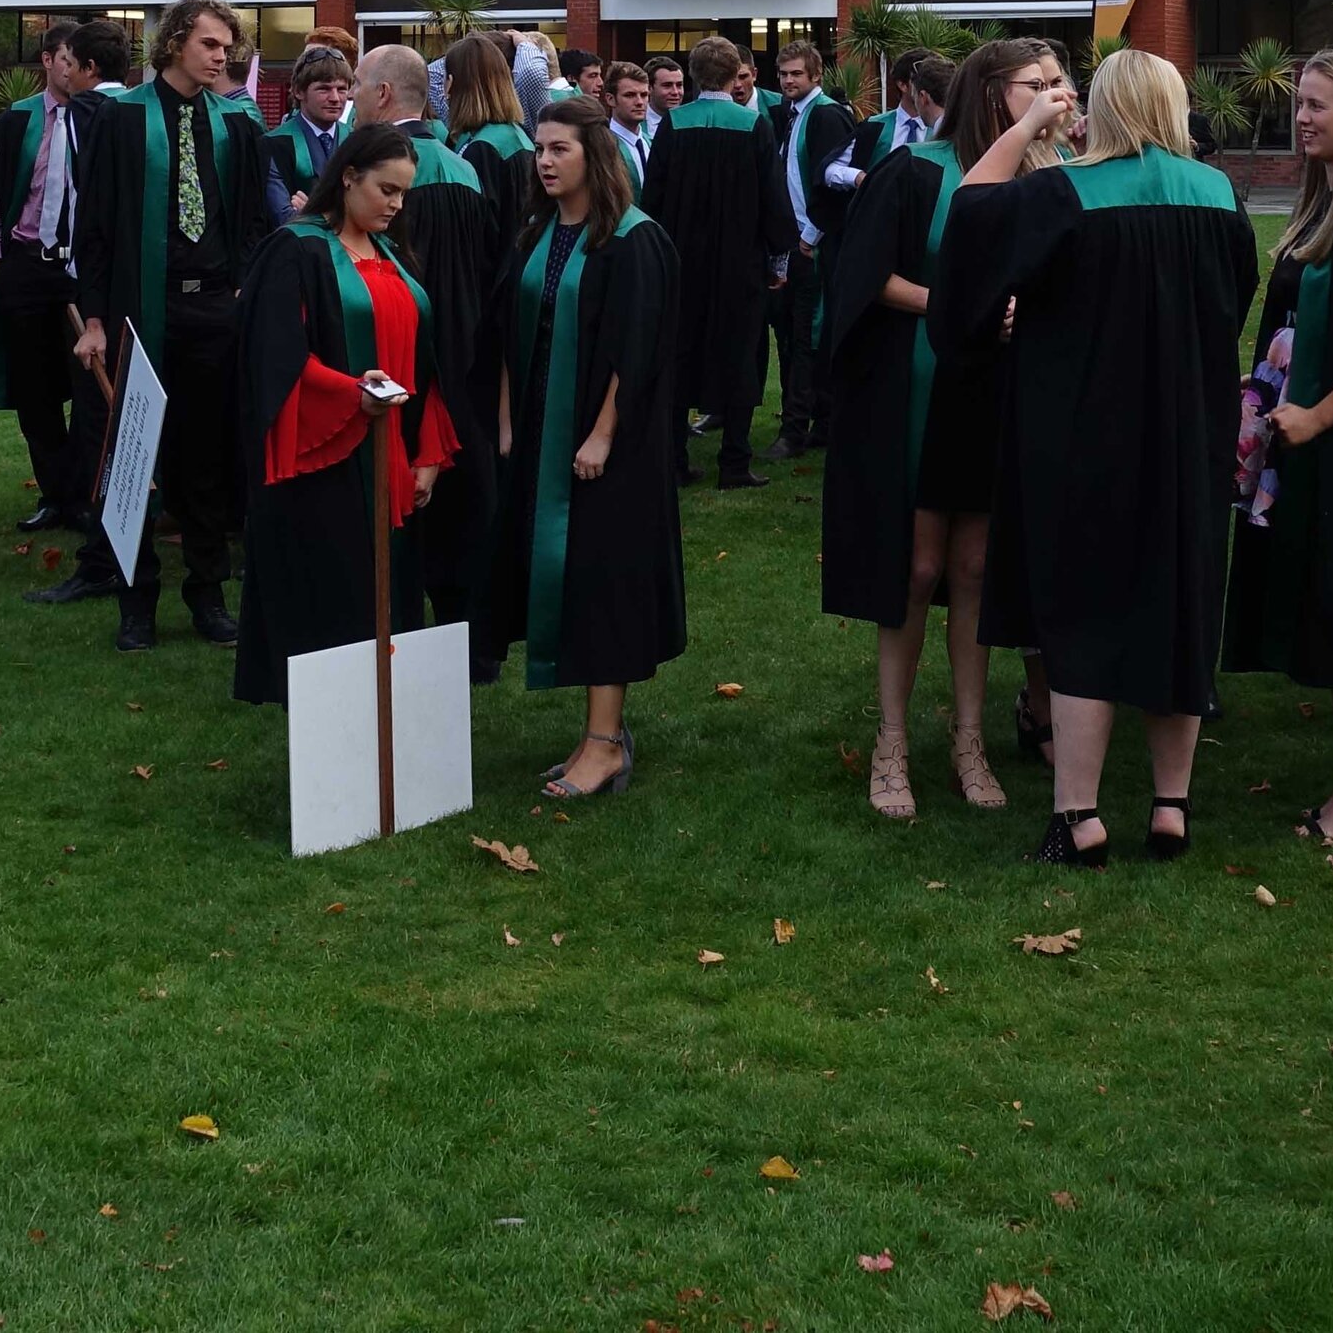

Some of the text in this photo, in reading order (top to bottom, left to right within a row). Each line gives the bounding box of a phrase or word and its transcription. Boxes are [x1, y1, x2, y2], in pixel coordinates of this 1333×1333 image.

[114, 391, 134, 491] Management
[116, 391, 141, 514] and Horticulture
[120, 395, 149, 535] Farm Management
[137, 449, 148, 497] Diploma
